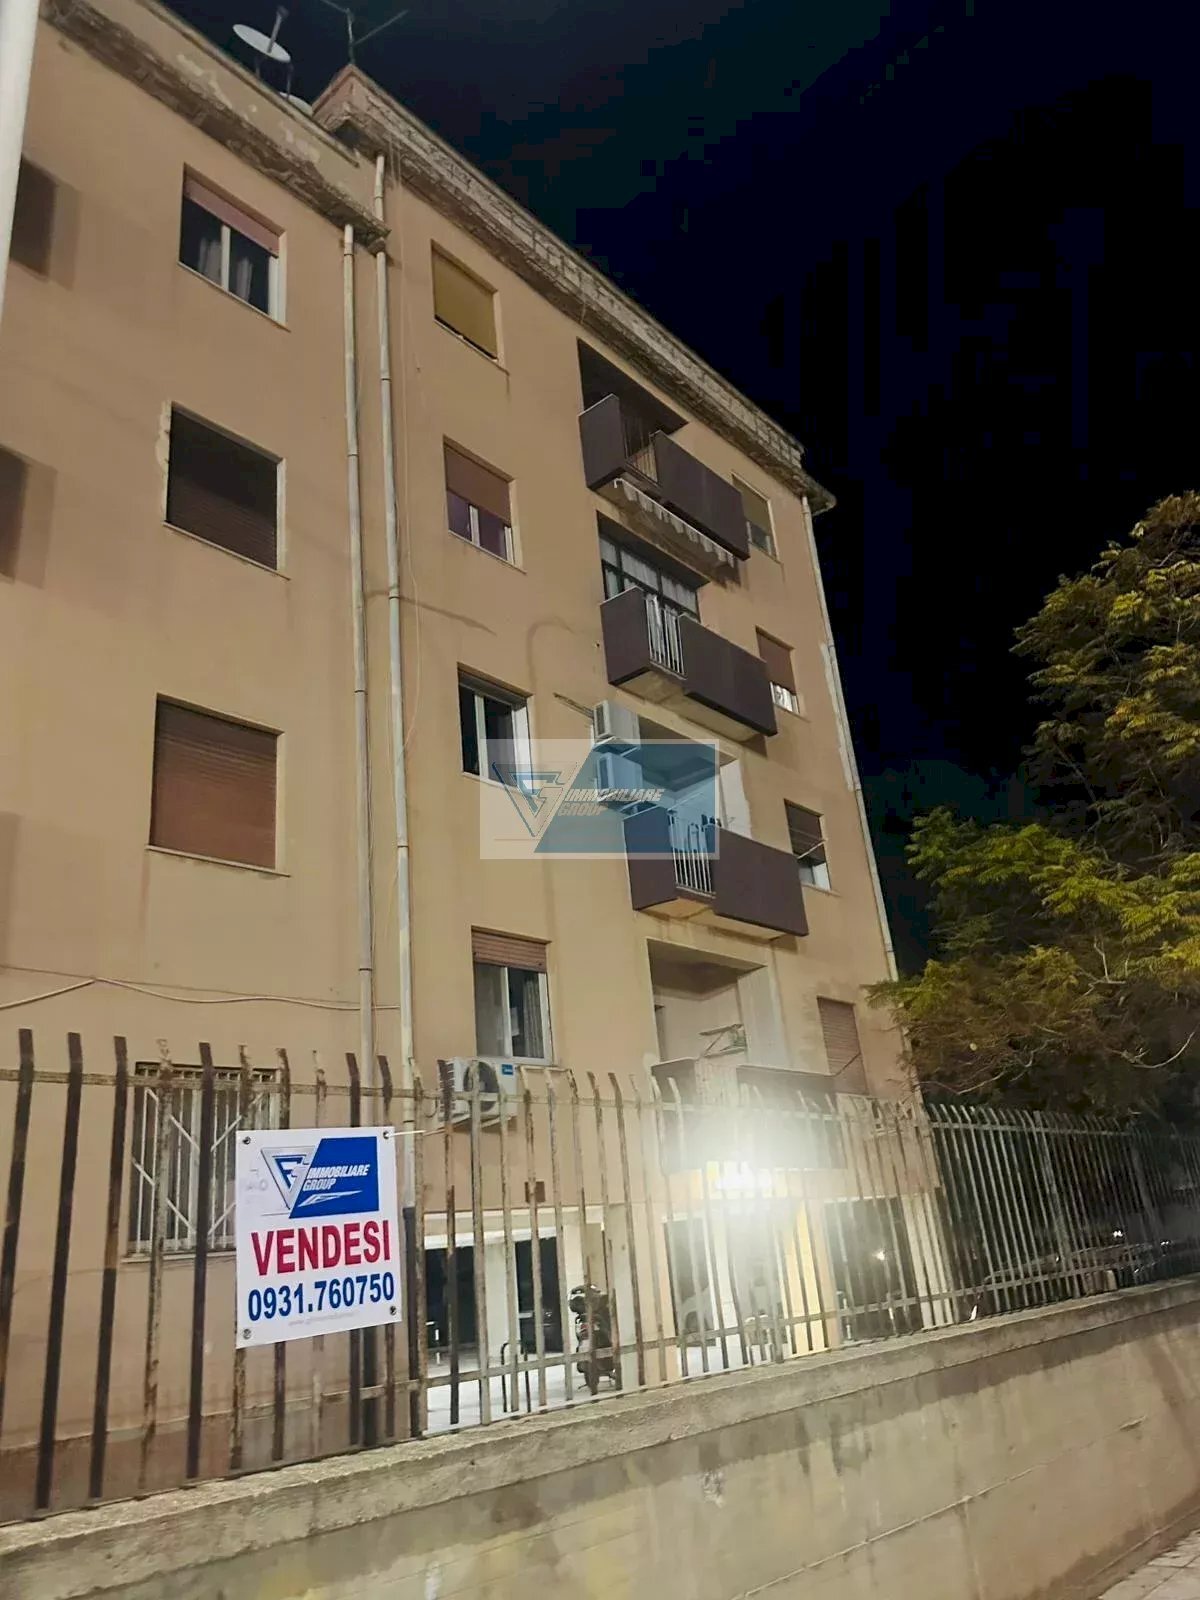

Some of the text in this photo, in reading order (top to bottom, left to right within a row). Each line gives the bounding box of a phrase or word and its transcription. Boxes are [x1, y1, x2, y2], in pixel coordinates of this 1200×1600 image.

[303, 1178, 337, 1192] GROUP
[306, 1164, 370, 1179] IMMOBILIARE
[251, 1220, 391, 1276] VENDESI
[248, 1271, 395, 1322] 0931.760750
